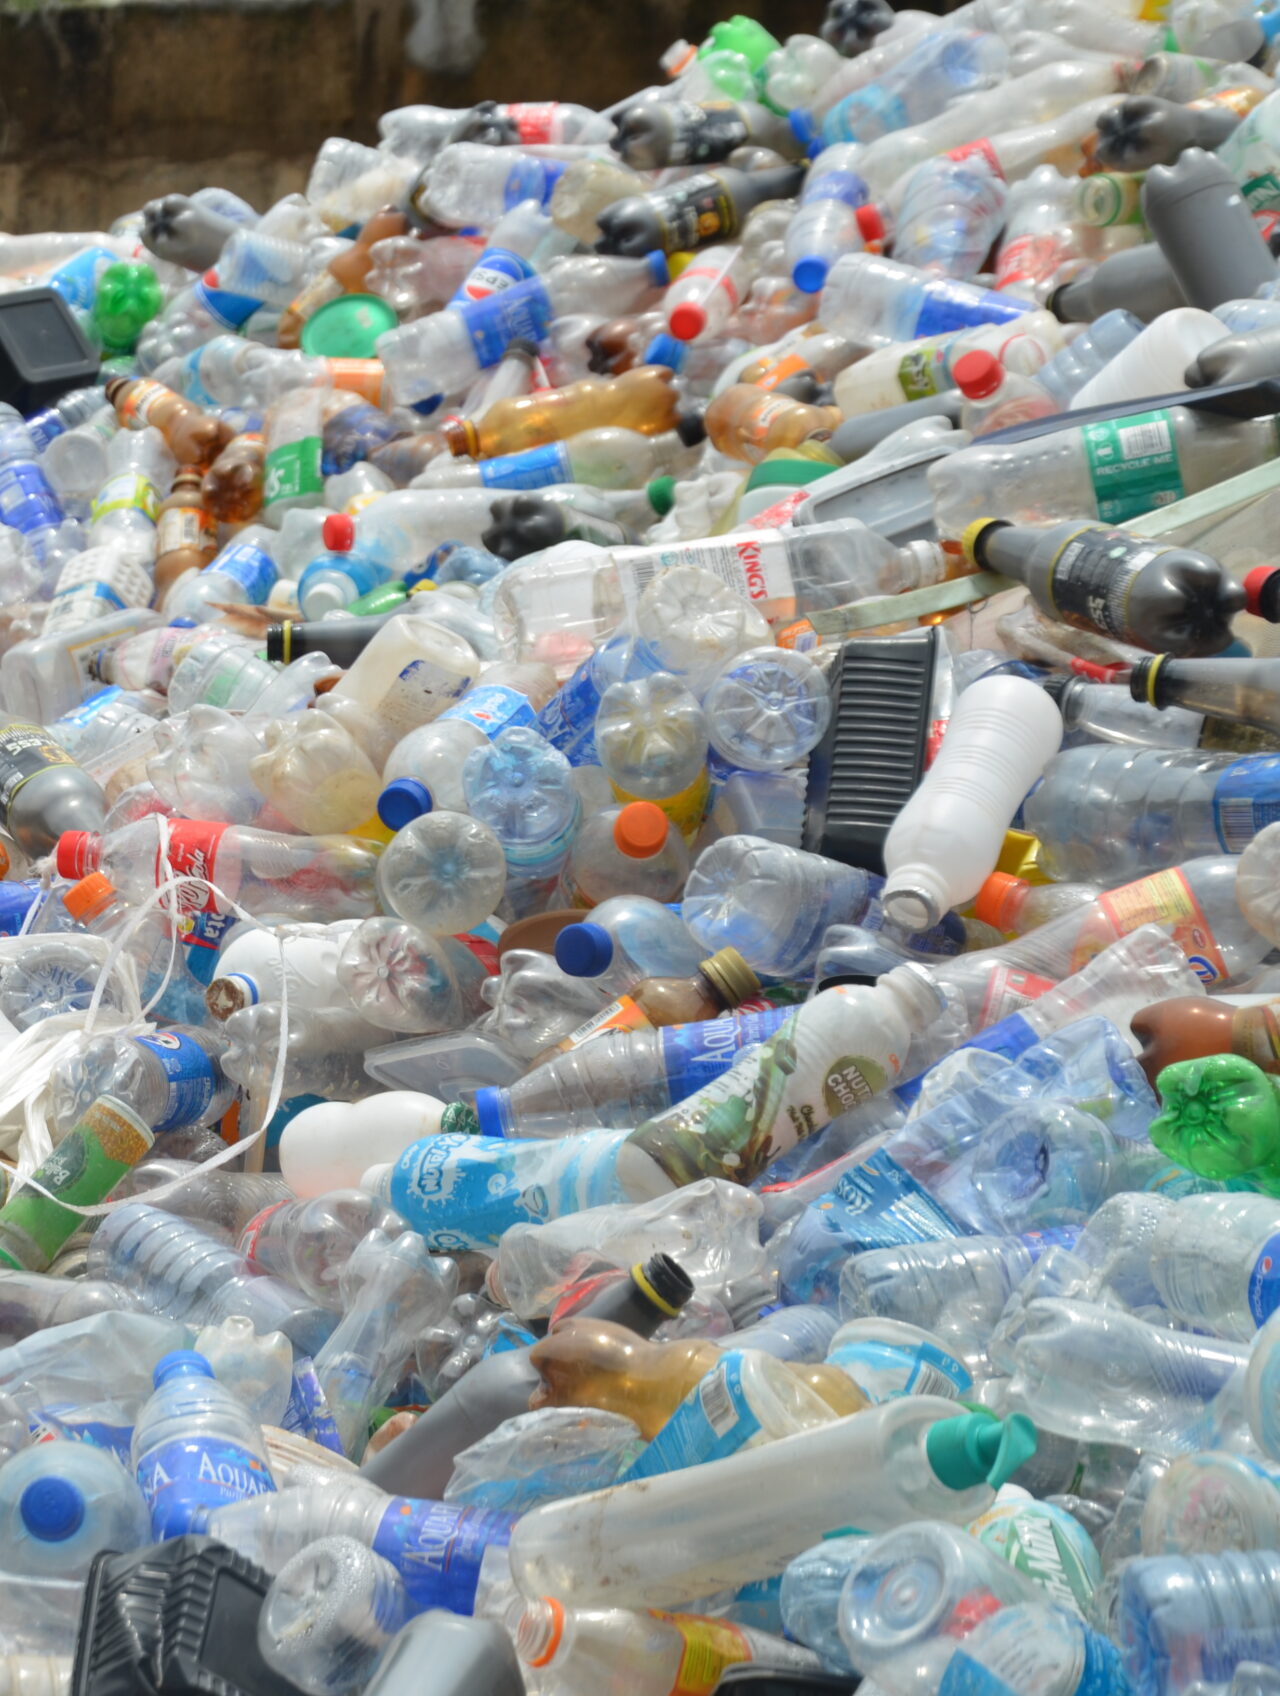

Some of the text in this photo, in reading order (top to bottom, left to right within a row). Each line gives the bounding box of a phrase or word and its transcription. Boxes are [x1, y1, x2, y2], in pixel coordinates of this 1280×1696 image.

[507, 294, 537, 341] AQUAF
[735, 540, 768, 600] KING'S
[691, 1017, 740, 1062] AQUA
[199, 1452, 276, 1493] AQUAF
[414, 1502, 460, 1572] AQUAF
